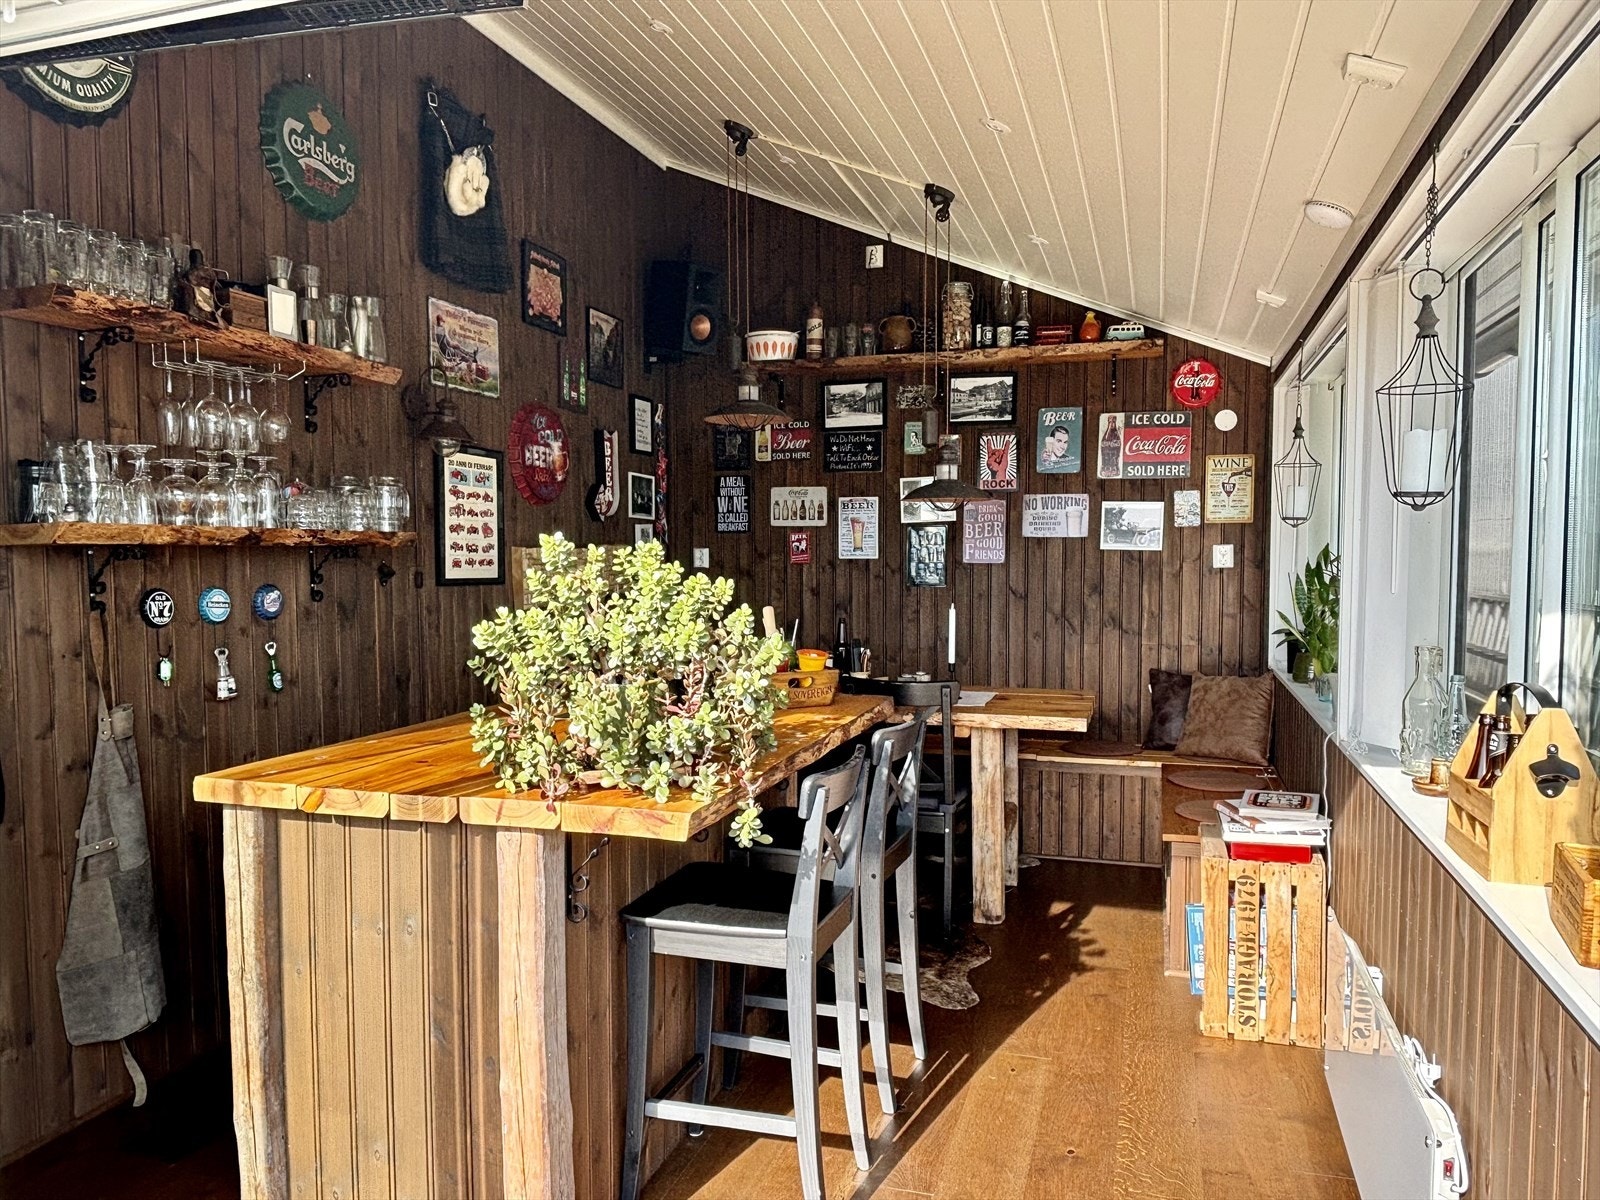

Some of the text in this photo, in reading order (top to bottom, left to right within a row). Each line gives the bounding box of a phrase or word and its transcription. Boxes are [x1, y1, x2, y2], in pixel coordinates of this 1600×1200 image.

[76, 73, 117, 97] QUALITY
[282, 116, 355, 183] Carlsberg
[1174, 373, 1217, 388] Coca-Cola
[788, 420, 810, 429] COLD
[1131, 413, 1185, 425] ICE COLD
[773, 432, 811, 450] Beer
[1125, 434, 1188, 455] Coca-Cola
[772, 451, 811, 460] SOLD HERE
[1212, 457, 1249, 468] WINE
[603, 440, 614, 502] BEER
[1127, 464, 1186, 476] SOLD HERE
[720, 476, 746, 487] A MEAL
[982, 479, 1015, 489] ROCK
[719, 487, 746, 497] WITHOUT
[841, 501, 875, 510] BEER
[1024, 495, 1088, 511] NO WORKING
[717, 513, 749, 523] IS CALLED
[978, 513, 1004, 522] GOOD
[717, 522, 749, 532] BREAKFAST
[964, 521, 1004, 538] BEER
[976, 537, 1004, 550] GOOD
[964, 543, 1005, 560] FRIENDS
